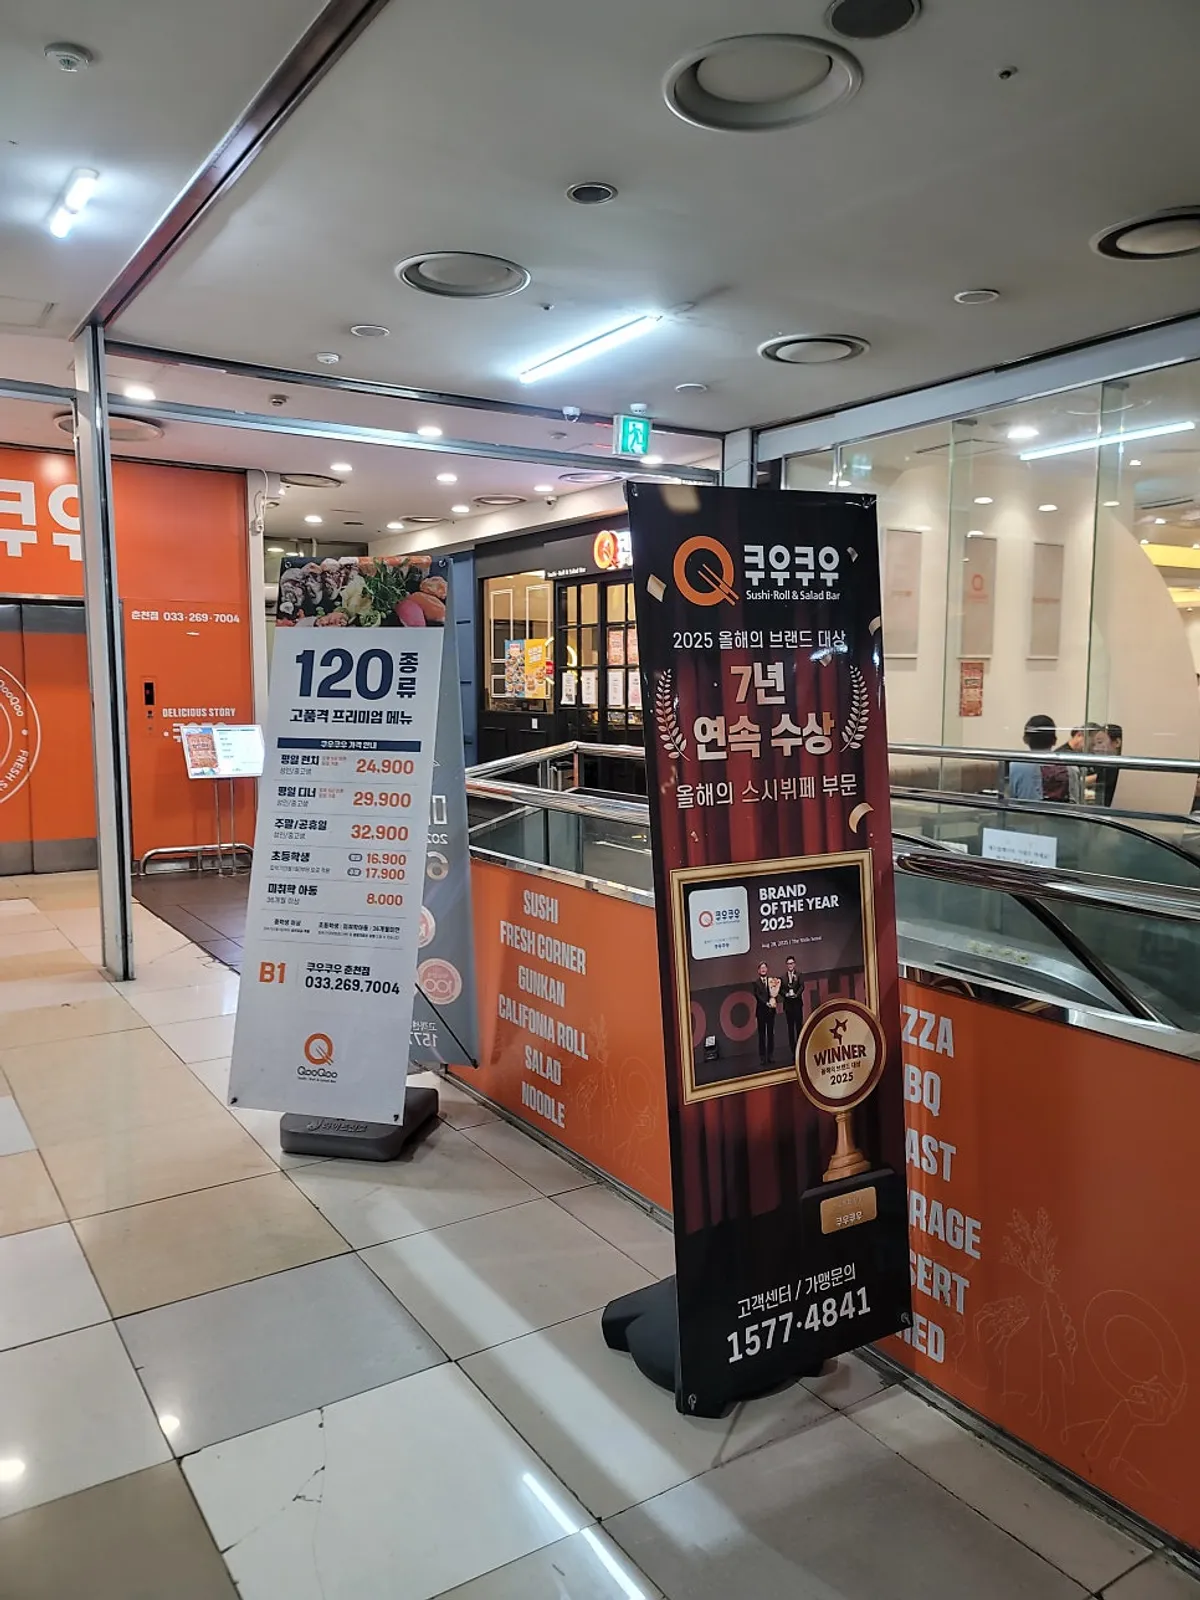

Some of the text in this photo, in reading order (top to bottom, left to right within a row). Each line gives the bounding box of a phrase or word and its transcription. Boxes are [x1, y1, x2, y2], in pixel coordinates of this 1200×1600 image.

[744, 545, 839, 587] 쿠우쿠우
[792, 591, 799, 600] &
[800, 590, 824, 600] Salad
[826, 591, 840, 600] Bar
[673, 630, 846, 649] 2025 올해의 브랜드 대상
[296, 647, 418, 700] 120 종류
[730, 661, 785, 706] 7년
[162, 707, 236, 718] DELICIOUS STORY
[290, 708, 413, 725] 고품격 프리미엄 메뉴
[694, 711, 835, 761] 연속 수상
[5, 749, 29, 782] FRESH
[281, 754, 299, 765] 평일
[301, 755, 319, 766] 런치
[278, 786, 296, 797] 평일
[298, 787, 316, 798] 디너
[676, 773, 857, 809] 올해의 스시뷔페 부문
[274, 818, 327, 831] 주말/공휴일
[271, 851, 310, 862] 초등학생
[267, 883, 318, 896] 미취학 아동
[759, 884, 806, 900] BRAND
[760, 894, 839, 916] OF THE YEAR
[523, 889, 559, 924] SUSHI
[760, 916, 794, 932] 2025
[500, 920, 587, 976] FRESH CORNER
[259, 962, 287, 984] B1
[305, 976, 400, 995] 033.269.7004
[306, 962, 371, 977] 쿠우쿠우 춘천점
[518, 965, 566, 1008] GUNKAN
[498, 994, 589, 1060] CALIFONIA ROLL
[900, 1004, 954, 1058] ZZA
[525, 1045, 562, 1086] SALAD
[814, 1044, 866, 1066] WINNER
[297, 1065, 338, 1079] QooQoo
[830, 1071, 854, 1086] 2025
[522, 1081, 565, 1129] NOODLE
[904, 1063, 942, 1117] BQ
[906, 1128, 956, 1182] AST
[907, 1189, 981, 1261] RAGE
[737, 1262, 856, 1319] 고객센터 / 가맹문의
[910, 1248, 970, 1315] SERT
[896, 1311, 945, 1363] ED
